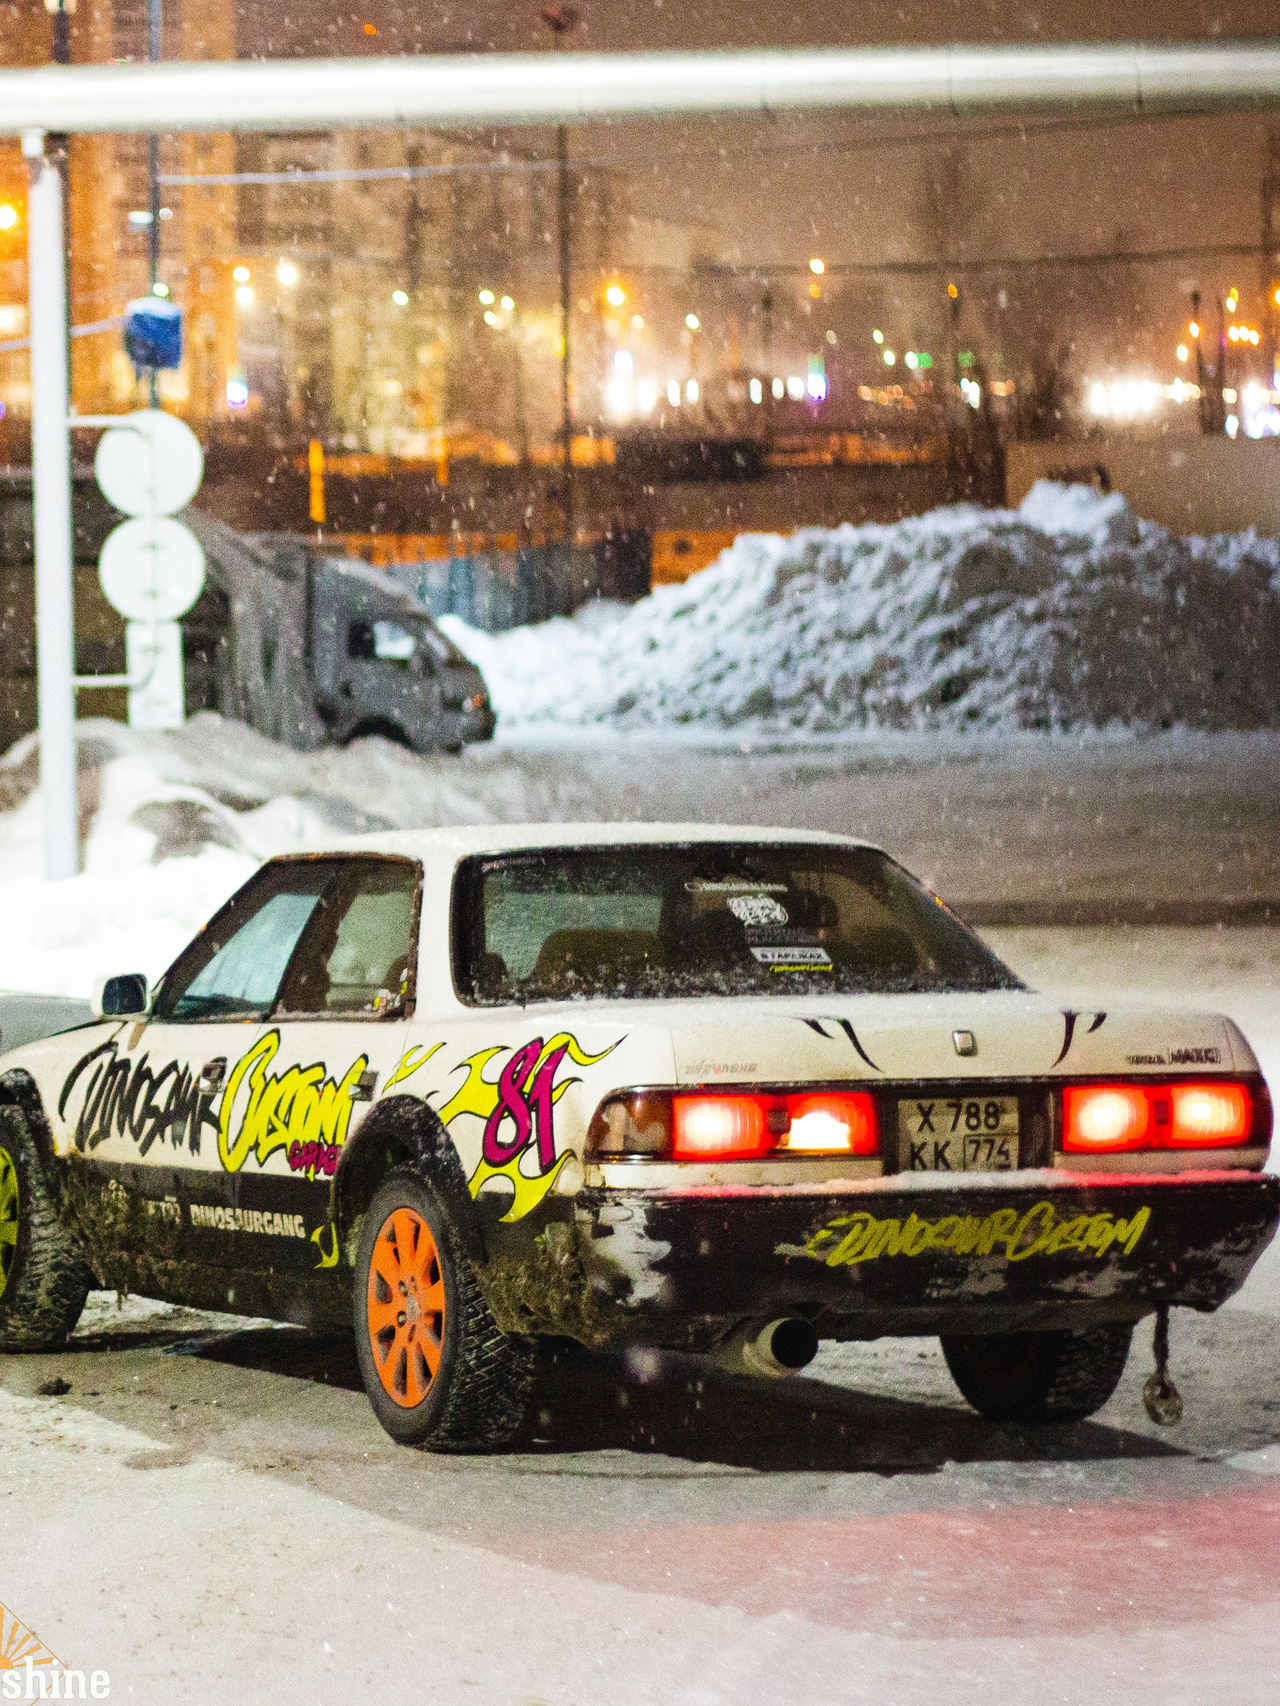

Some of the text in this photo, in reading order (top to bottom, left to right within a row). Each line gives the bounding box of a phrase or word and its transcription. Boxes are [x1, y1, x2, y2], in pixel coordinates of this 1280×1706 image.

[483, 1036, 568, 1175] 81
[946, 1100, 1001, 1132] 788
[968, 1138, 1010, 1164] 774
[189, 1204, 306, 1239] DINOSAURGANG
